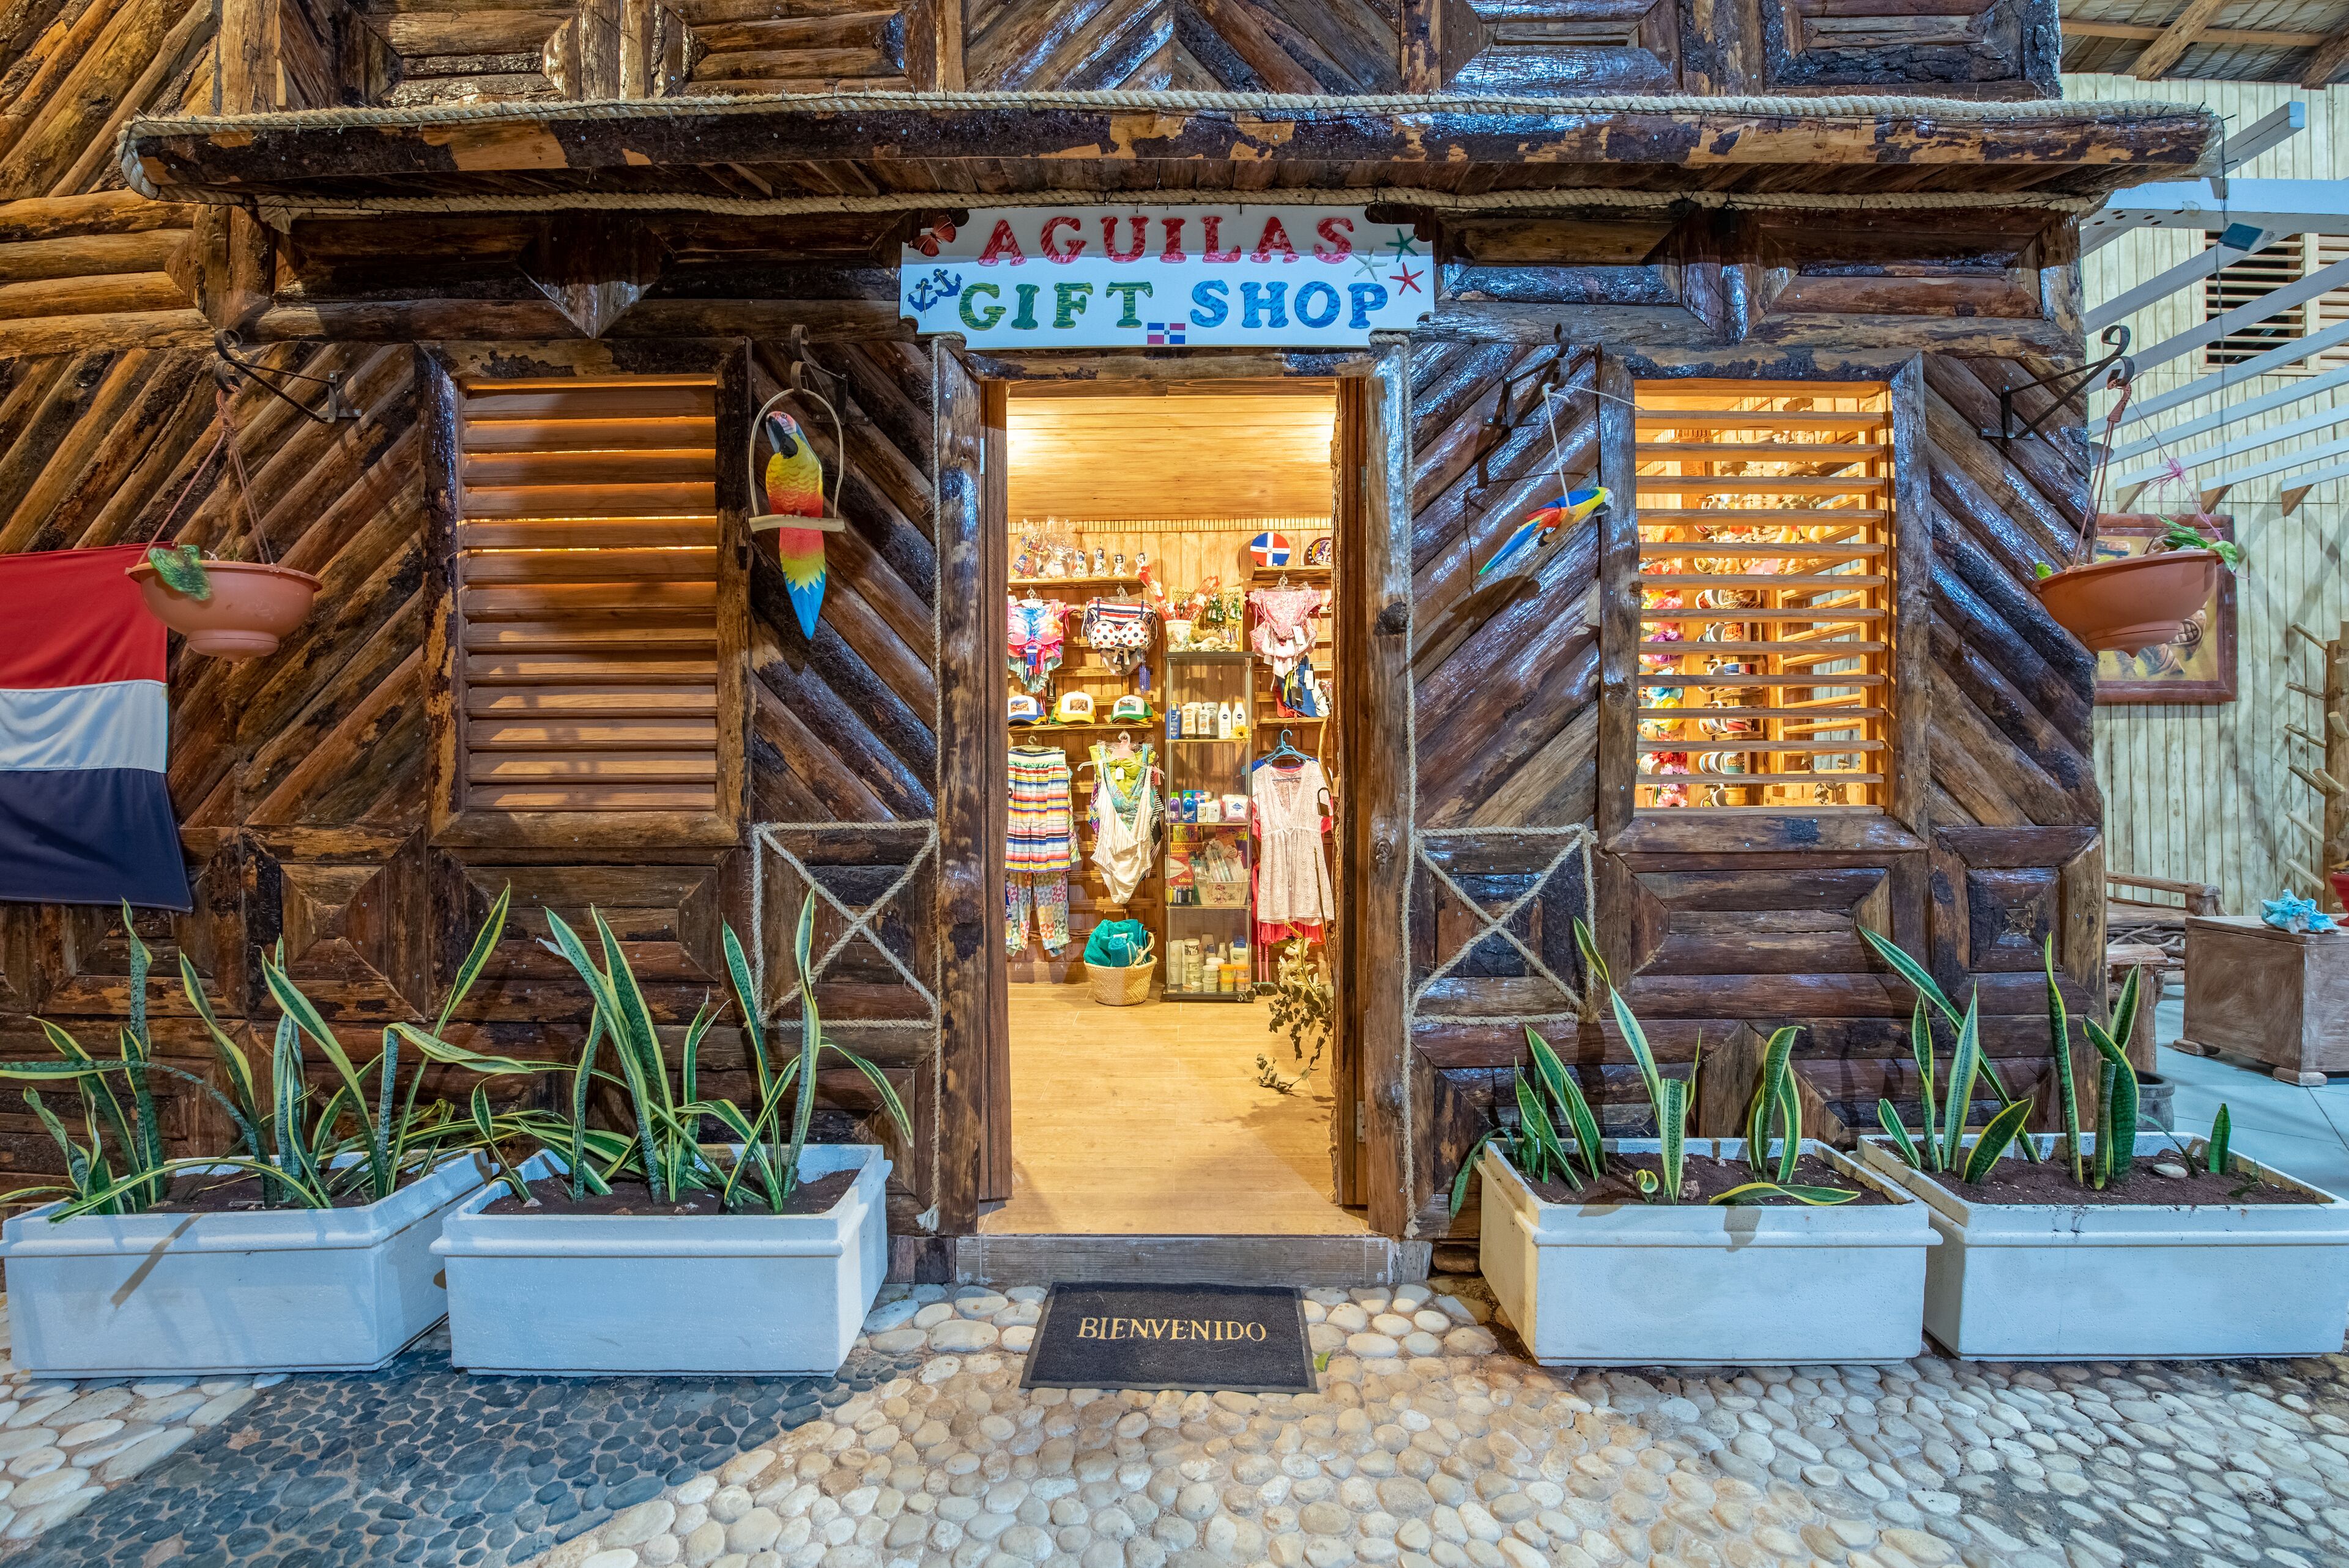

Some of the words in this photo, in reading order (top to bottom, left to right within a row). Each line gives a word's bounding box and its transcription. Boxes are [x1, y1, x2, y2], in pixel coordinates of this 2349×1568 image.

[978, 215, 1354, 267] AGUILAS
[958, 281, 1154, 331] GIFT
[1189, 278, 1389, 329] SHOP
[1076, 1317, 1267, 1342] BIENVENIDO
